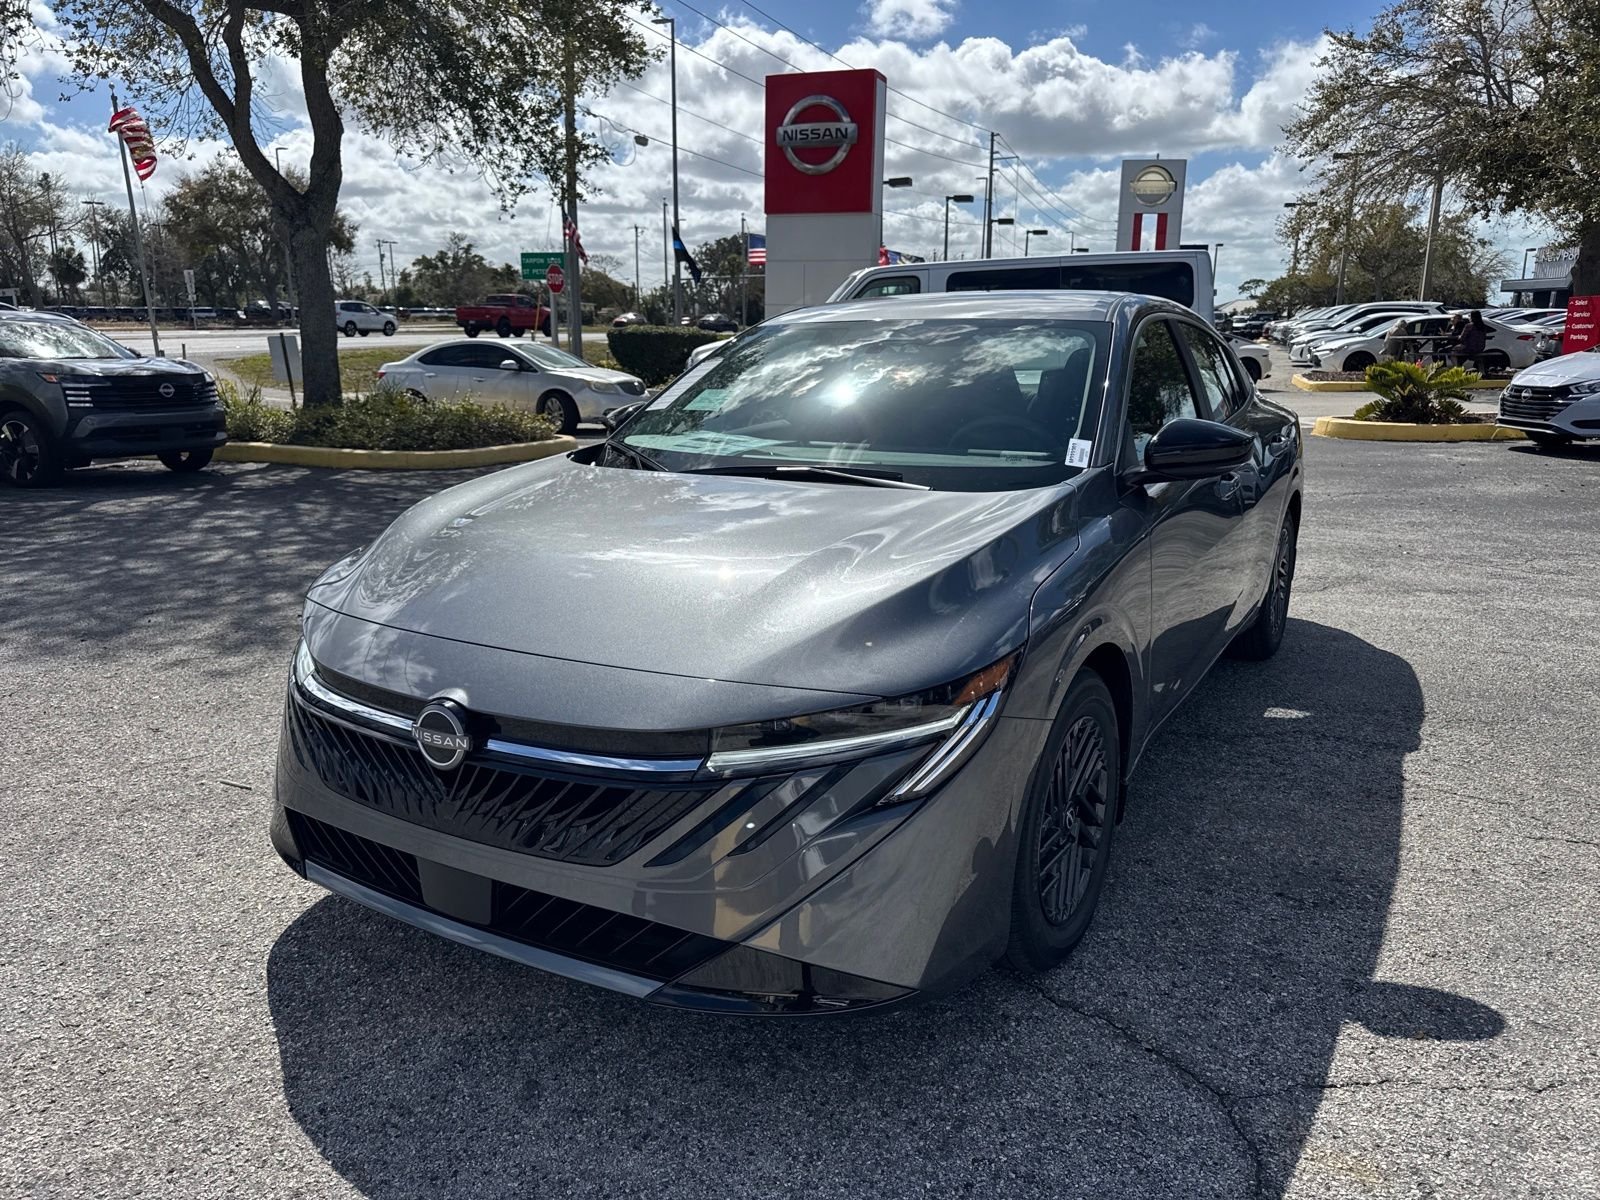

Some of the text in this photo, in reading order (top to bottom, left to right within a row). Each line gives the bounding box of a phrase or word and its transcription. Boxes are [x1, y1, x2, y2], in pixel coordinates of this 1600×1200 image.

[782, 127, 848, 141] NISSAN
[1562, 251, 1580, 262] Por
[548, 273, 563, 285] STOP
[412, 727, 467, 748] NISSAN
